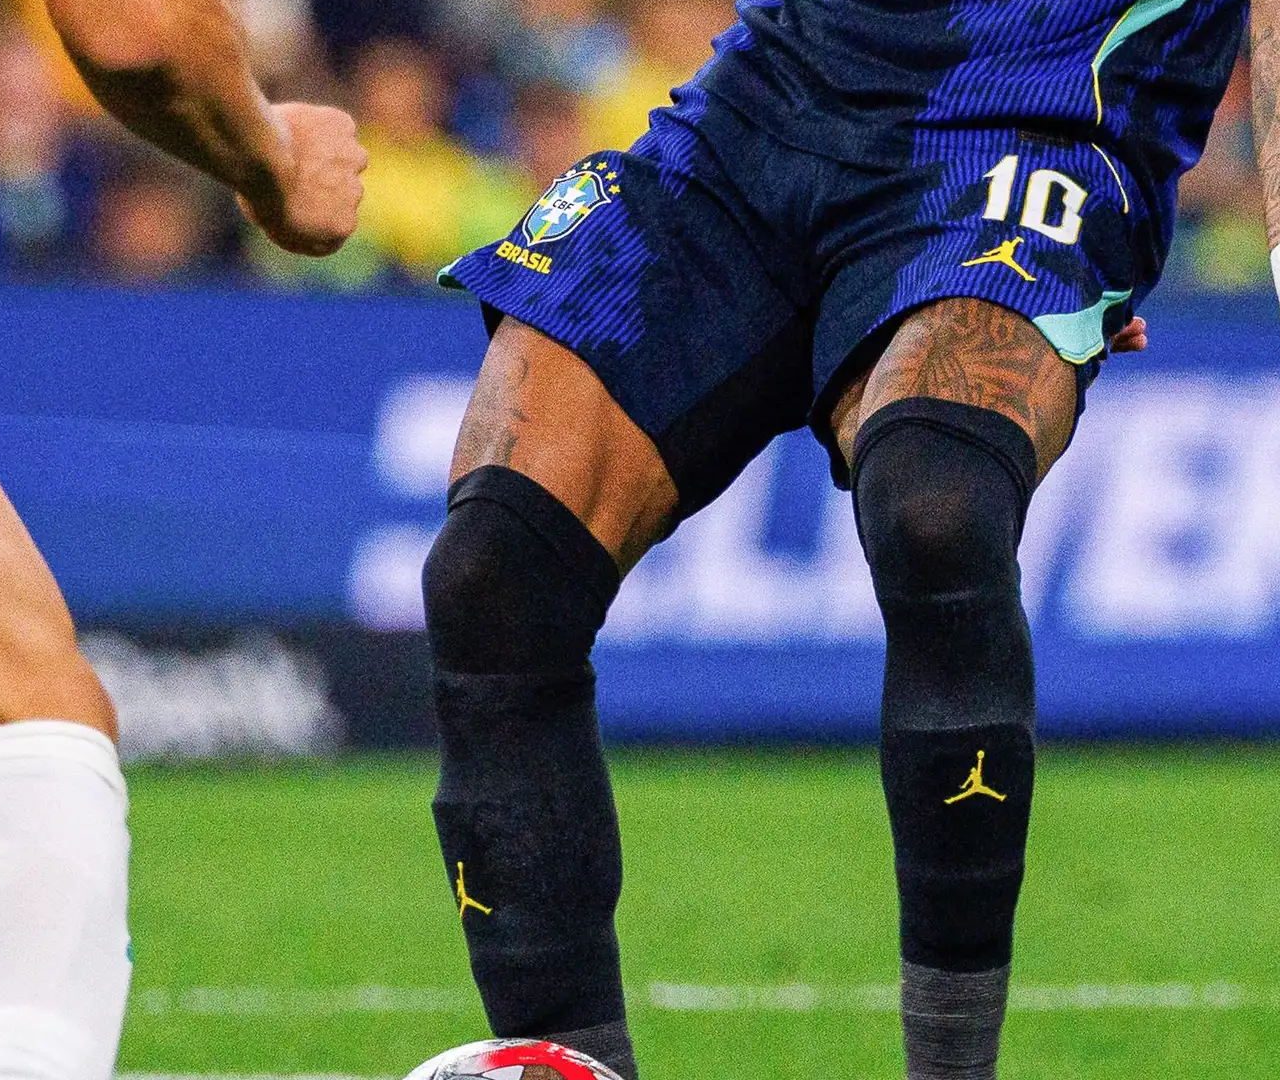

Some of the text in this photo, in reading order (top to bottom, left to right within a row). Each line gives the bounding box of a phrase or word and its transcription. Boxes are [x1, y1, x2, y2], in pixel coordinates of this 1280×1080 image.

[552, 198, 574, 211] CBF
[981, 154, 1089, 246] 10
[495, 240, 553, 275] BRASIL
